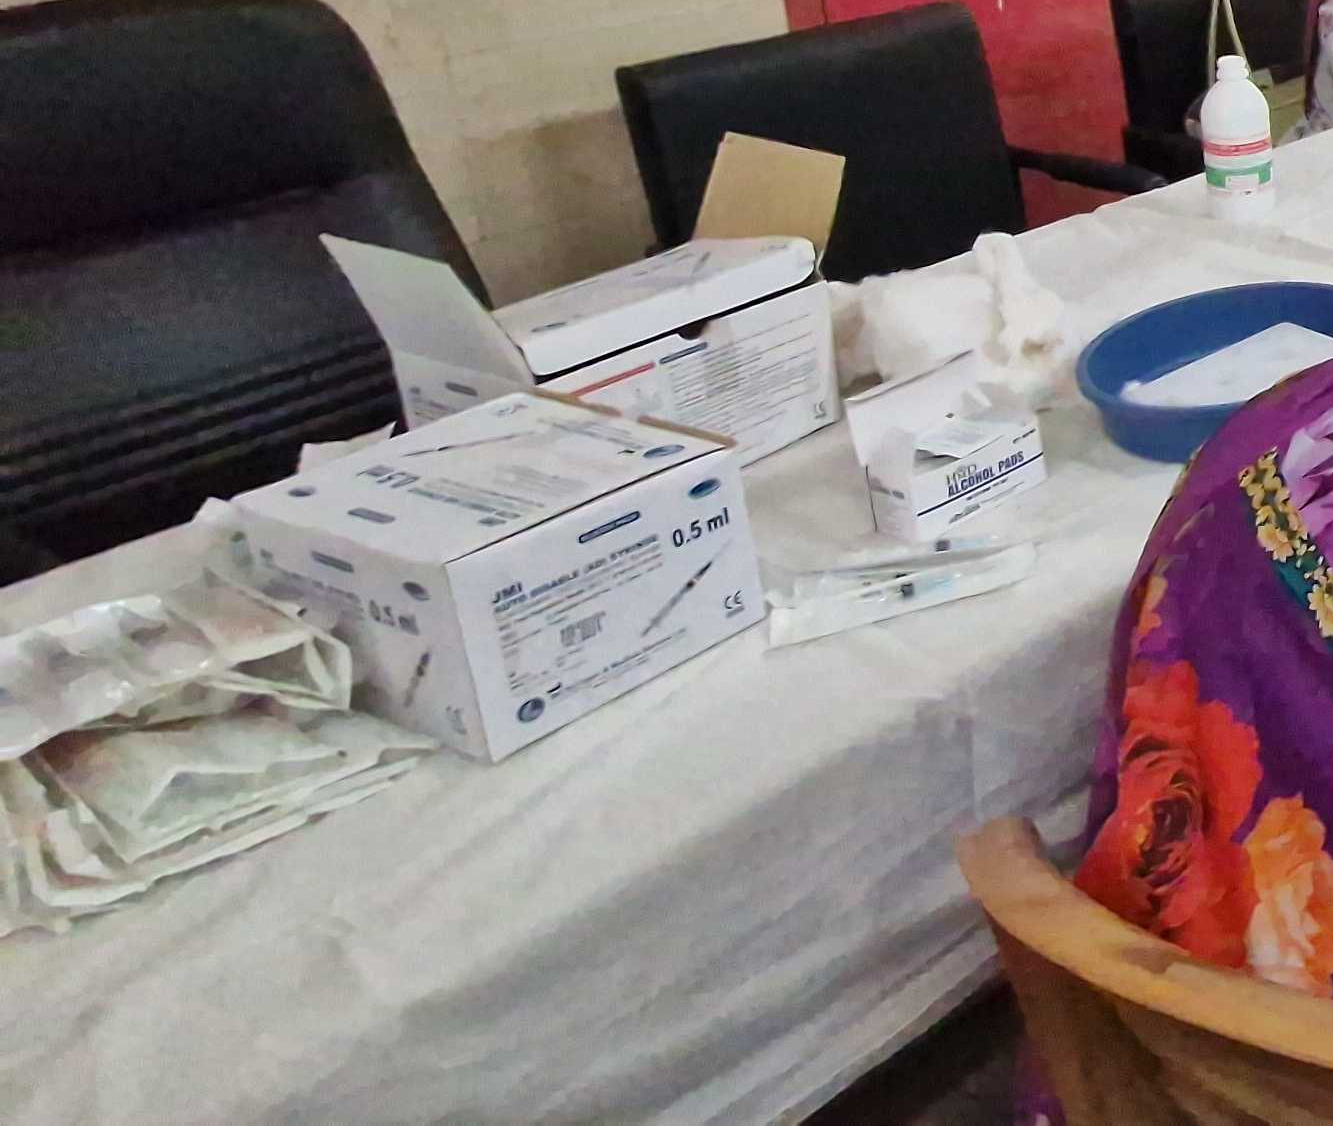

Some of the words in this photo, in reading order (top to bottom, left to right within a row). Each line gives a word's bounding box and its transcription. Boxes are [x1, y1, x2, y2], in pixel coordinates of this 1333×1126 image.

[948, 468, 995, 498] ALCOHOL
[998, 450, 1025, 472] PADS
[672, 519, 702, 548] 0.5
[707, 506, 730, 531] ml
[724, 590, 743, 610] CE
